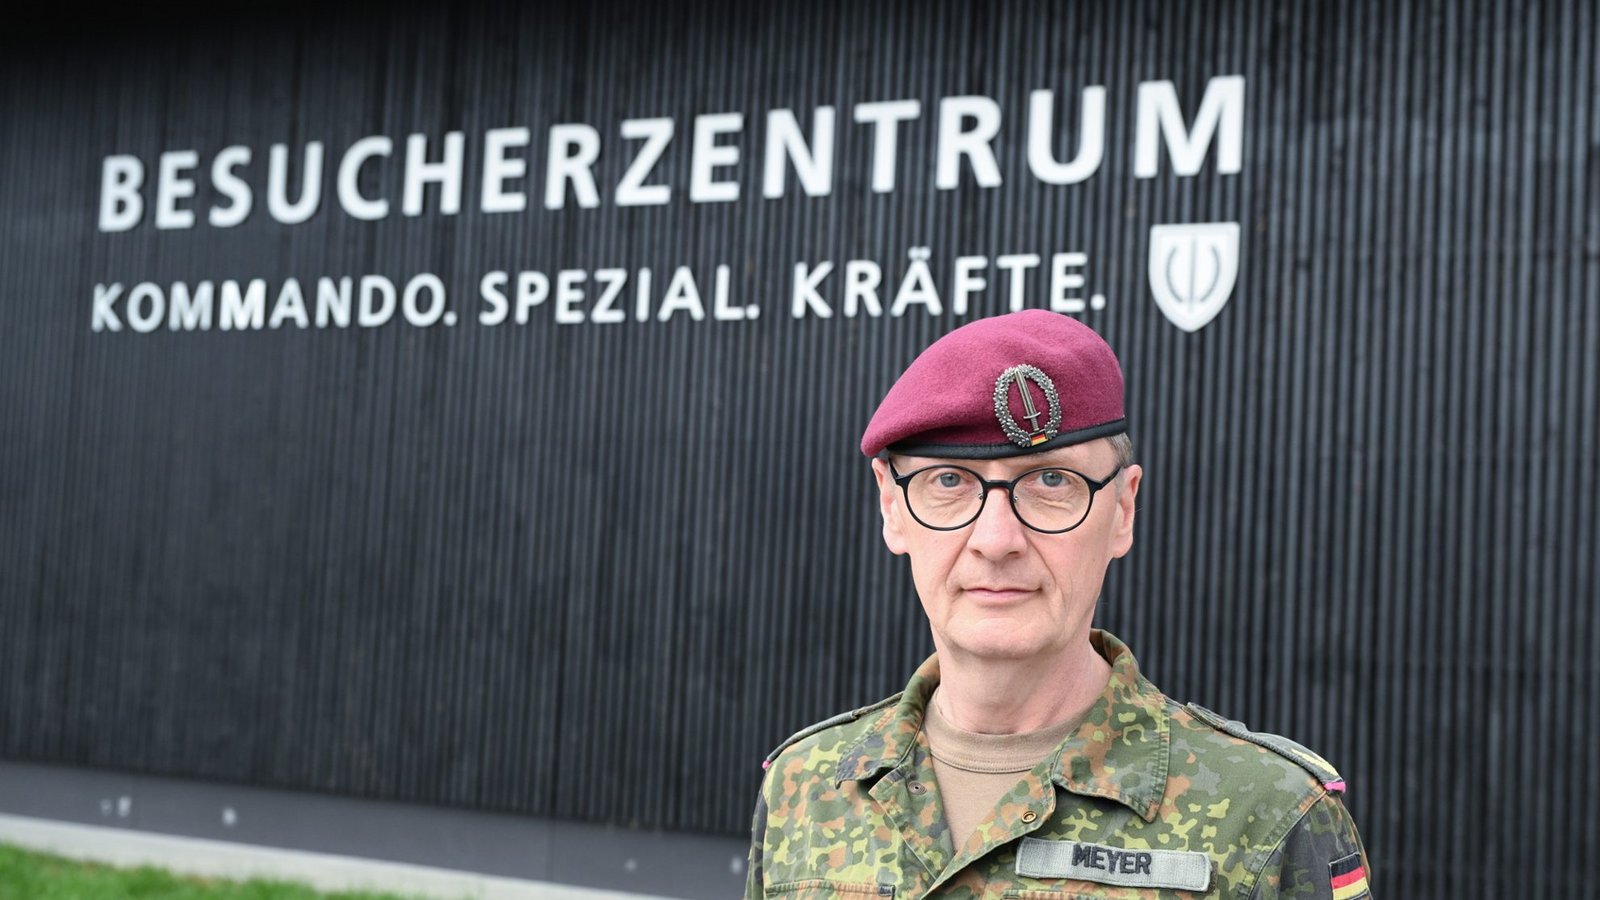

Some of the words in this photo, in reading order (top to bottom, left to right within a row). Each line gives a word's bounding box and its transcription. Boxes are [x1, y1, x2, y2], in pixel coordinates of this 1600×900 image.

[97, 74, 1246, 232] BESUCHERZENTRUM
[91, 272, 457, 333] KOMMANDO.
[479, 263, 760, 326] SPEZIAL.
[791, 246, 1106, 319] KRÄFTE.
[1071, 843, 1153, 876] MEYER
